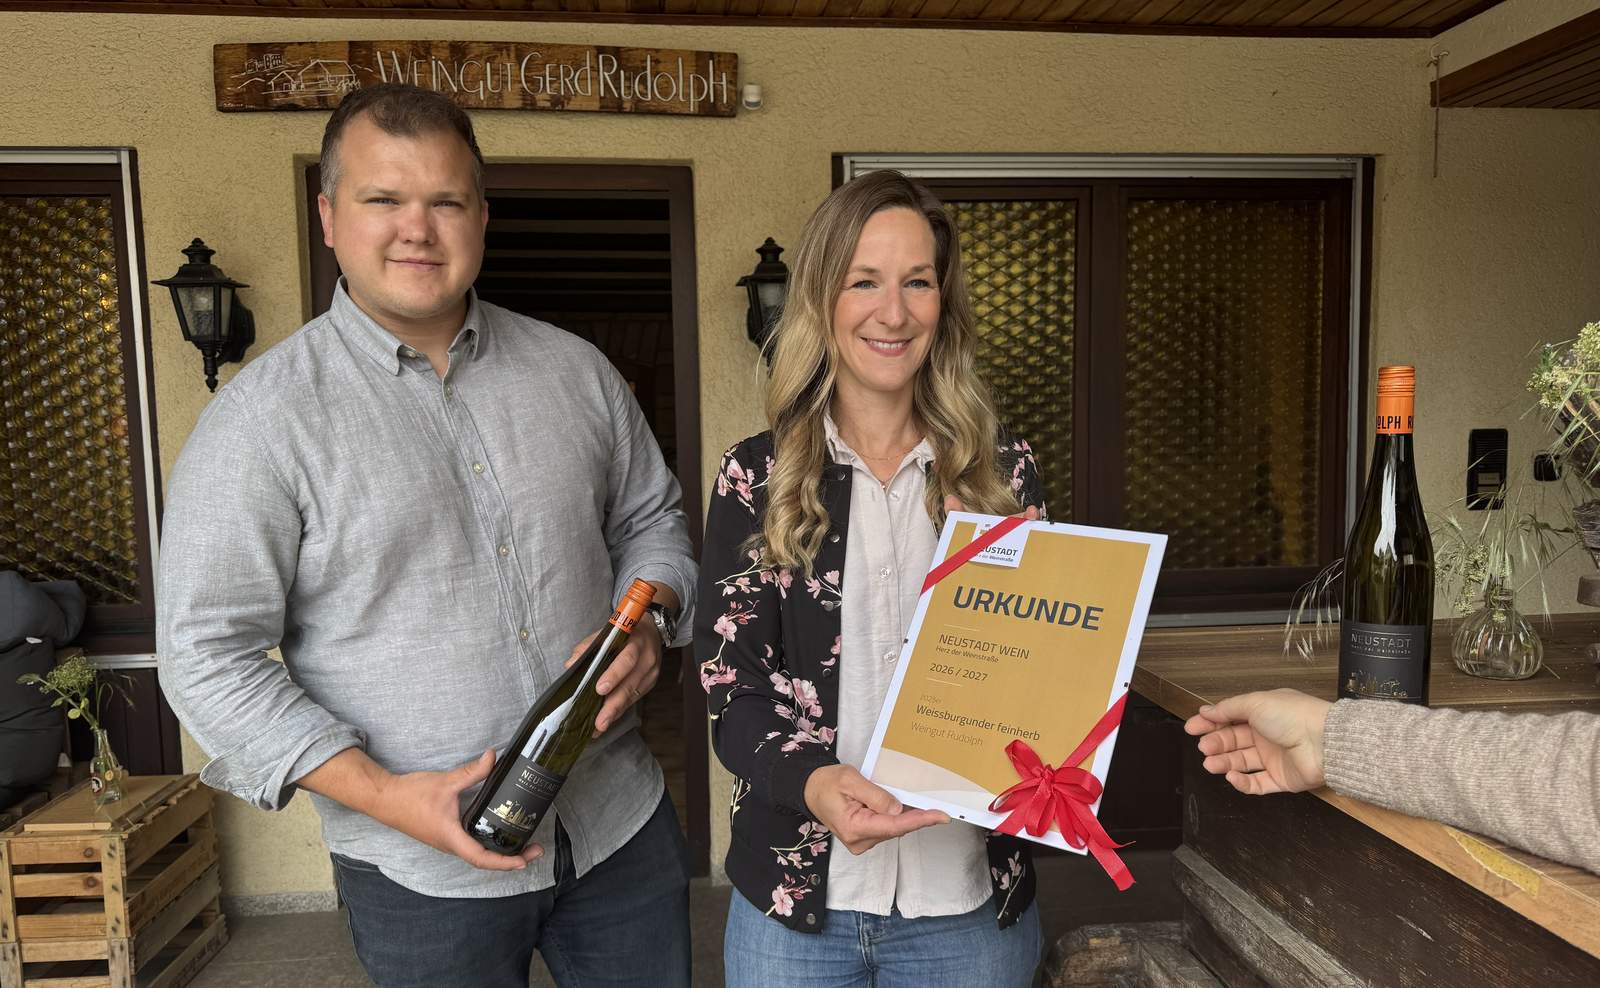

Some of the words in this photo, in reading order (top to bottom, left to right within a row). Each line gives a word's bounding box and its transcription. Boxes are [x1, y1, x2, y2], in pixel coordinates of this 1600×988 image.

[1376, 415, 1401, 430] OLPH
[953, 585, 1104, 631] URKUNDE
[938, 633, 998, 654] NEUSTADT
[999, 644, 1030, 660] WEIN
[1351, 633, 1413, 649] NEUSTADT
[935, 645, 950, 654] Herz
[951, 648, 963, 657] der
[962, 650, 1000, 664] Weinstraße
[929, 662, 955, 676] 2026
[962, 669, 988, 682] 2027
[916, 703, 995, 730] Weissburgunder
[997, 722, 1041, 741] feinherb
[911, 721, 946, 738] Weingut
[946, 729, 984, 746] Rudolph
